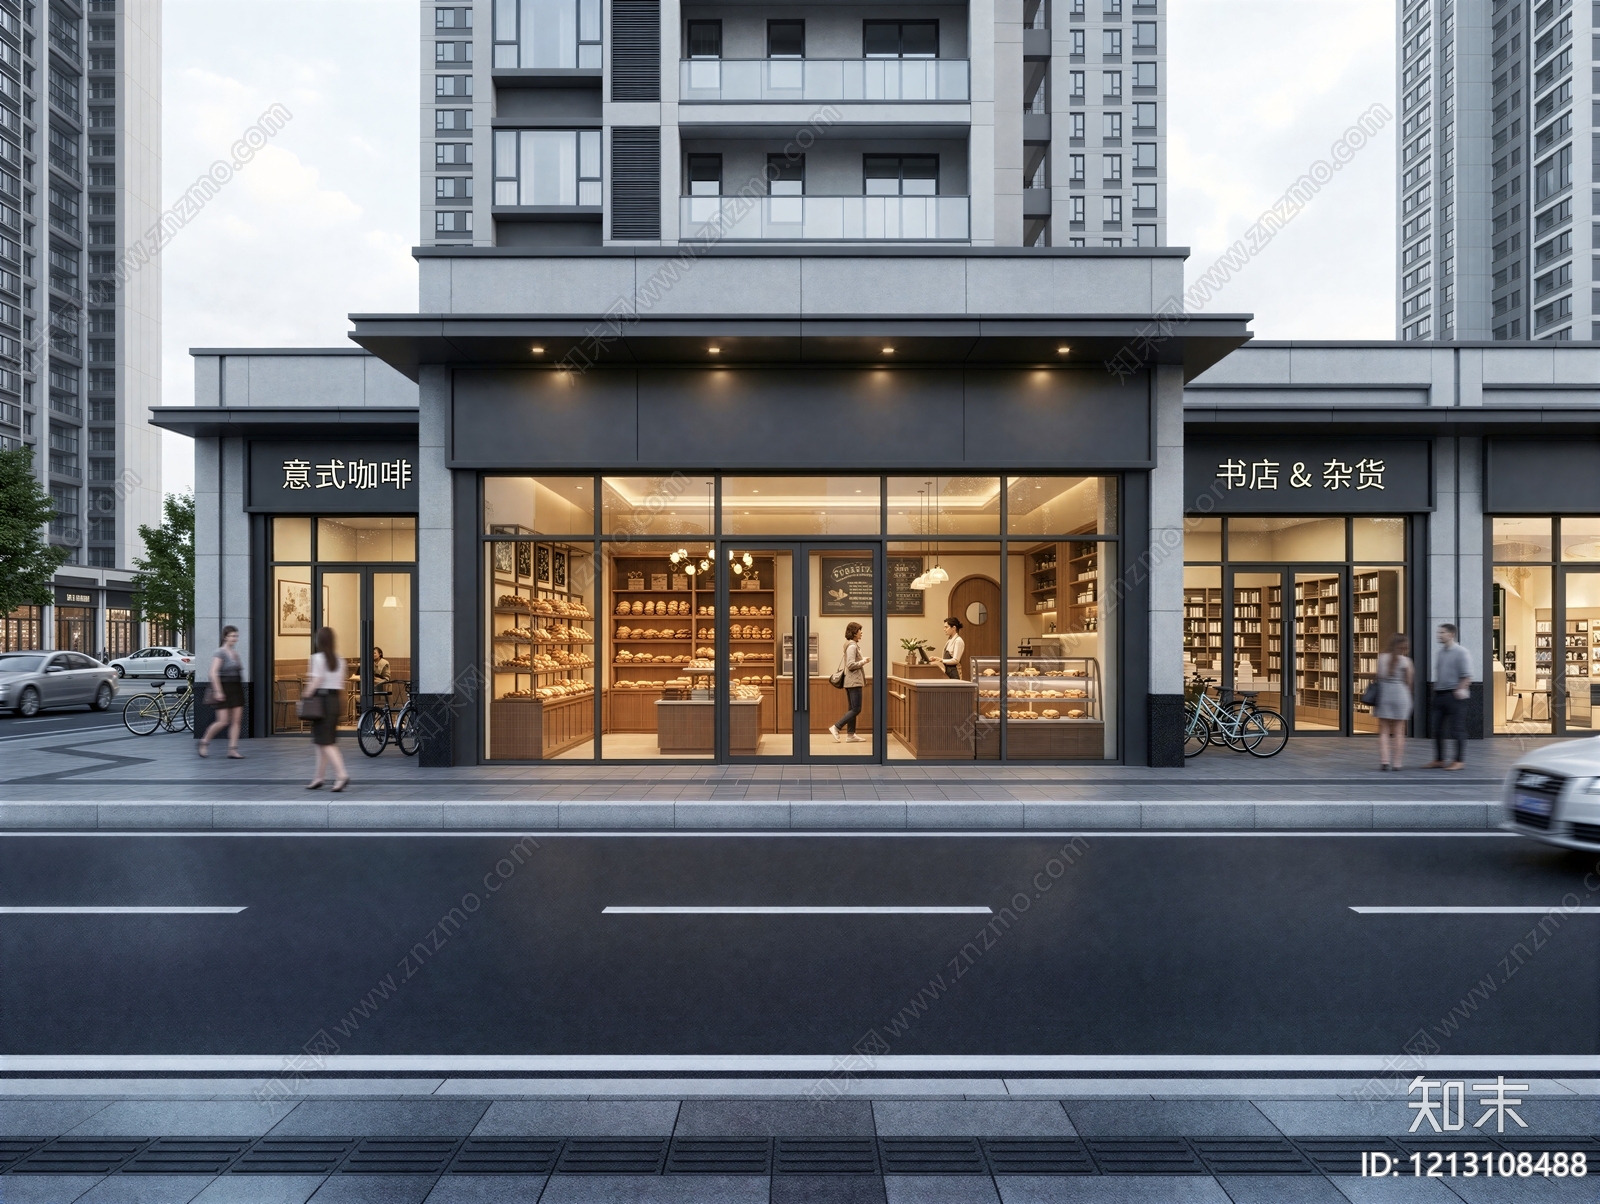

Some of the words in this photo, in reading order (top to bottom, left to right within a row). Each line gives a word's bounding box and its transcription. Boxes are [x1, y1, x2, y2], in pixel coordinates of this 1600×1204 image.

[282, 458, 412, 490] 意式咖啡
[1216, 458, 1280, 490] 书店
[1290, 461, 1313, 488] &
[1323, 458, 1386, 490] 杂货
